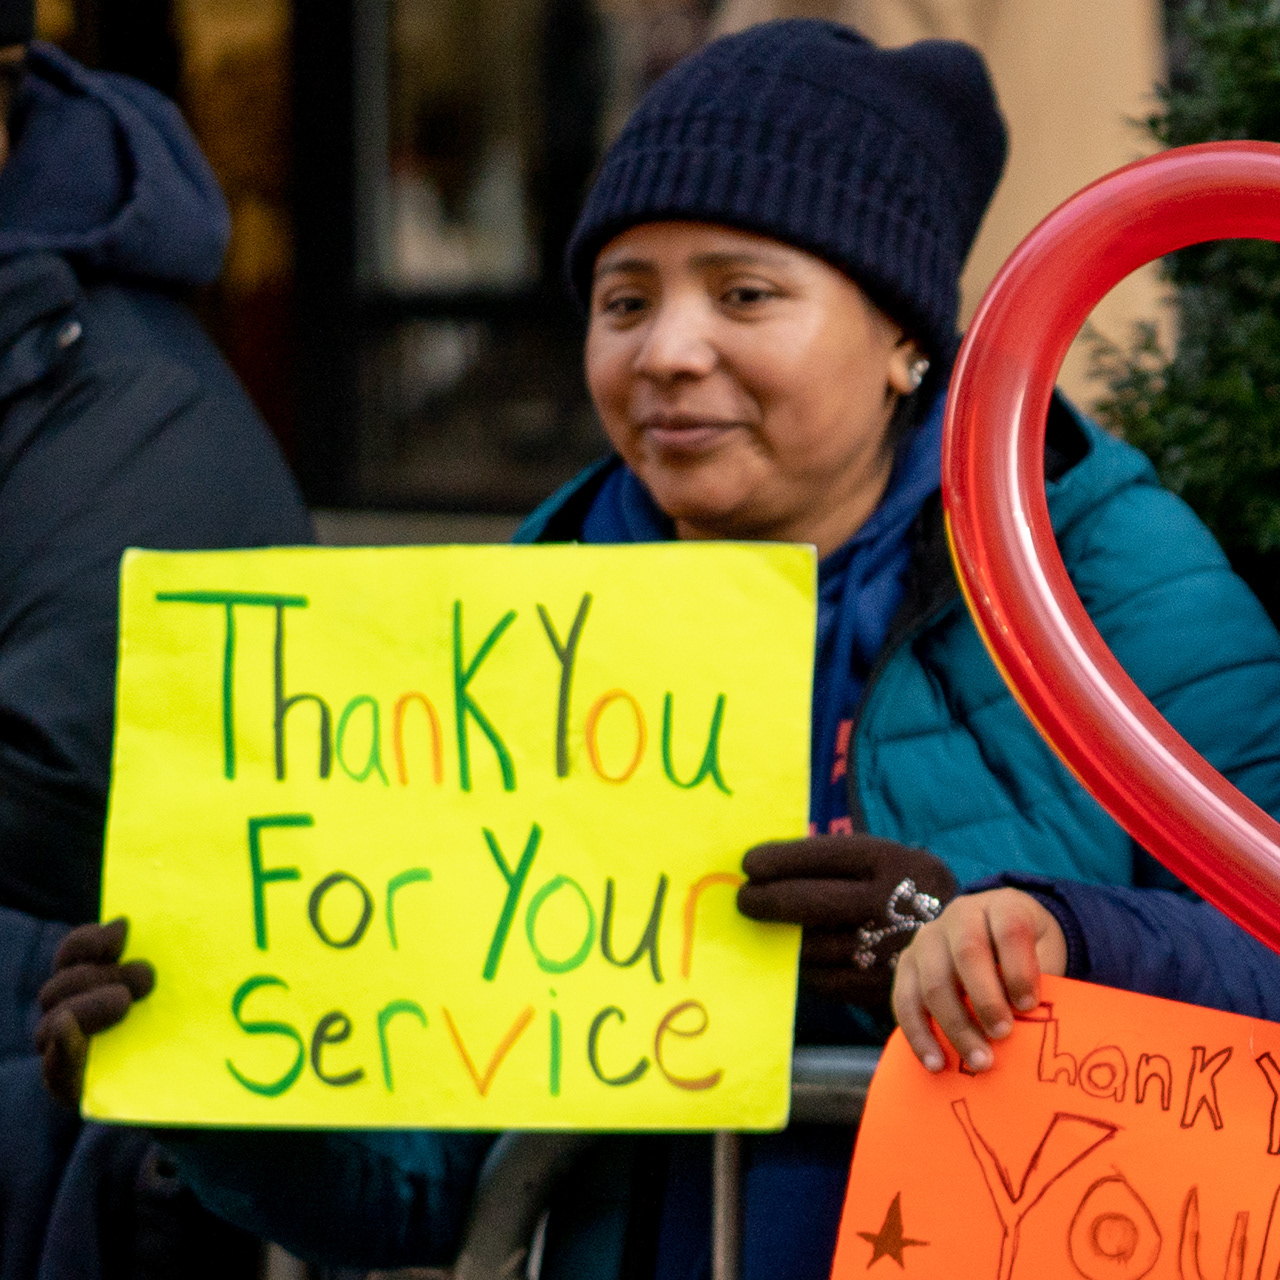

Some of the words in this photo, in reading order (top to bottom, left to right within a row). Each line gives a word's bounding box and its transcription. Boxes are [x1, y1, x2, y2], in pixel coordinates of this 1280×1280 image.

[248, 813, 432, 951] For
[481, 822, 743, 984] Your
[225, 973, 726, 1098] Service
